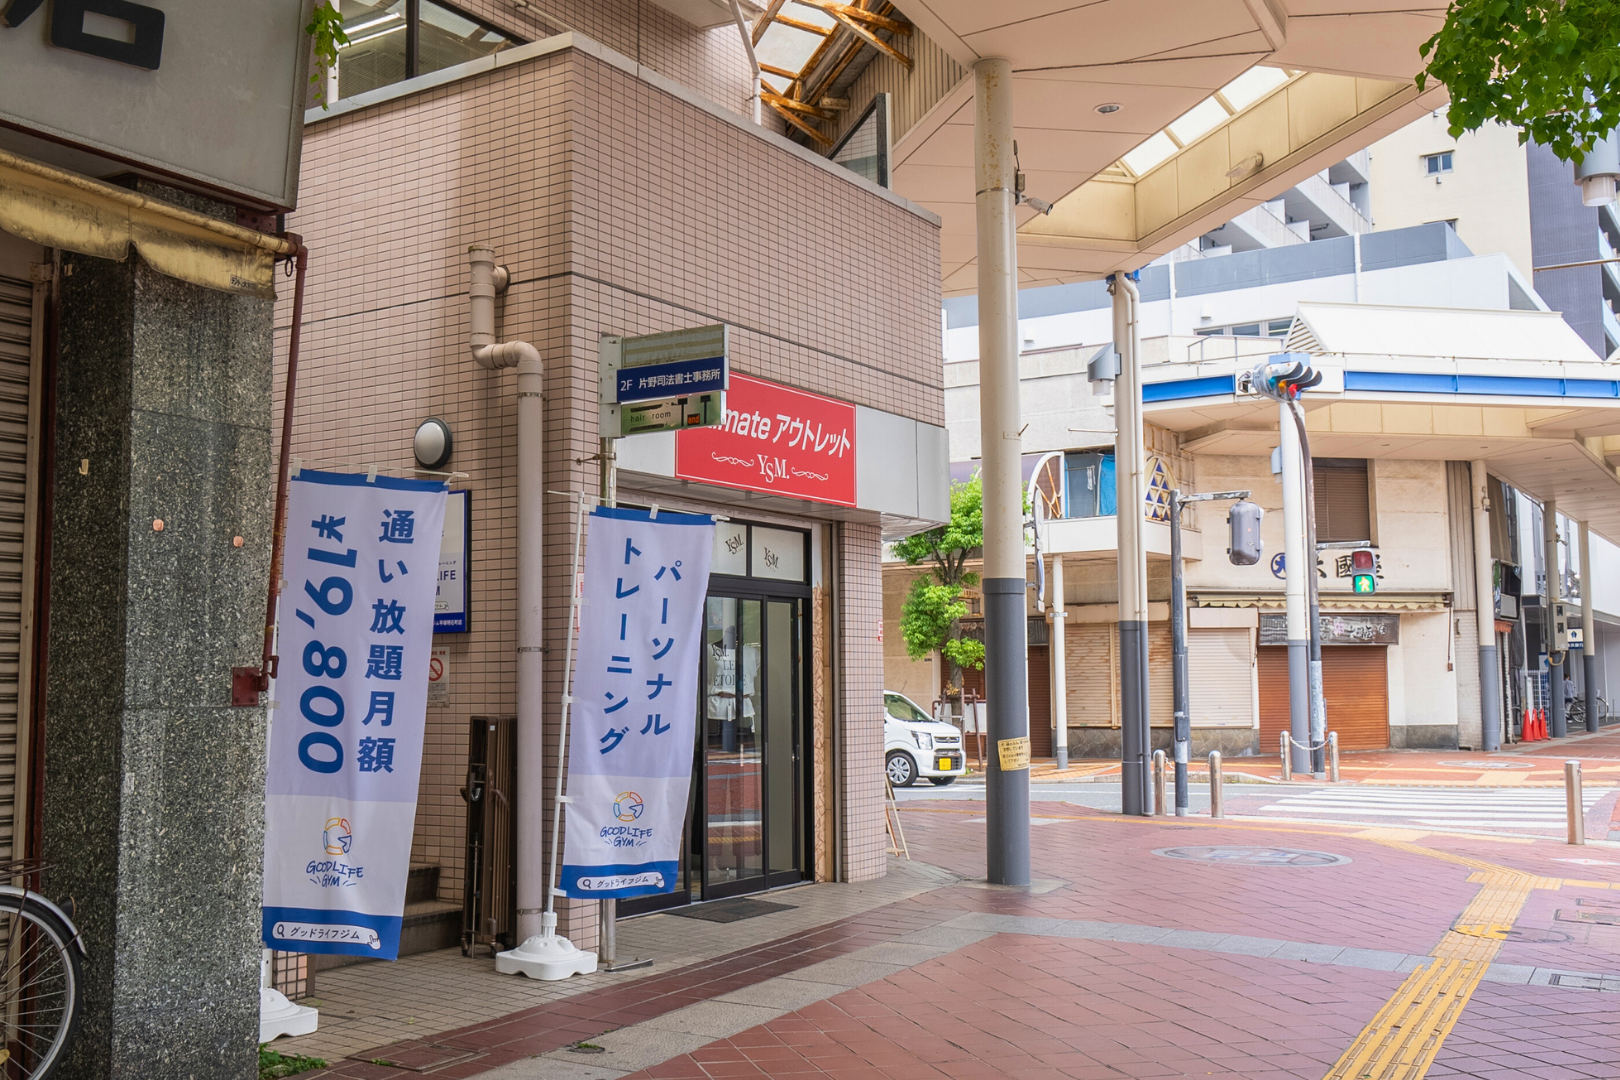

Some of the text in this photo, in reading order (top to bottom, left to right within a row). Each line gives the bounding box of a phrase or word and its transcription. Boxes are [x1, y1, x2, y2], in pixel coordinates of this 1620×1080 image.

[620, 368, 721, 391] 2F 片野司法書士事務所
[630, 411, 672, 423] hair room
[687, 414, 700, 425] and
[772, 413, 851, 458] アウトレット
[295, 513, 358, 774] ¥19,800
[357, 508, 415, 774] 通い放題月額
[599, 537, 642, 755] トレーニング
[639, 560, 682, 736] パーソナル
[613, 836, 634, 848] GYM
[321, 873, 341, 888] GYM
[596, 877, 649, 889] グッドライフジム
[290, 926, 360, 940] グッドライフジム
